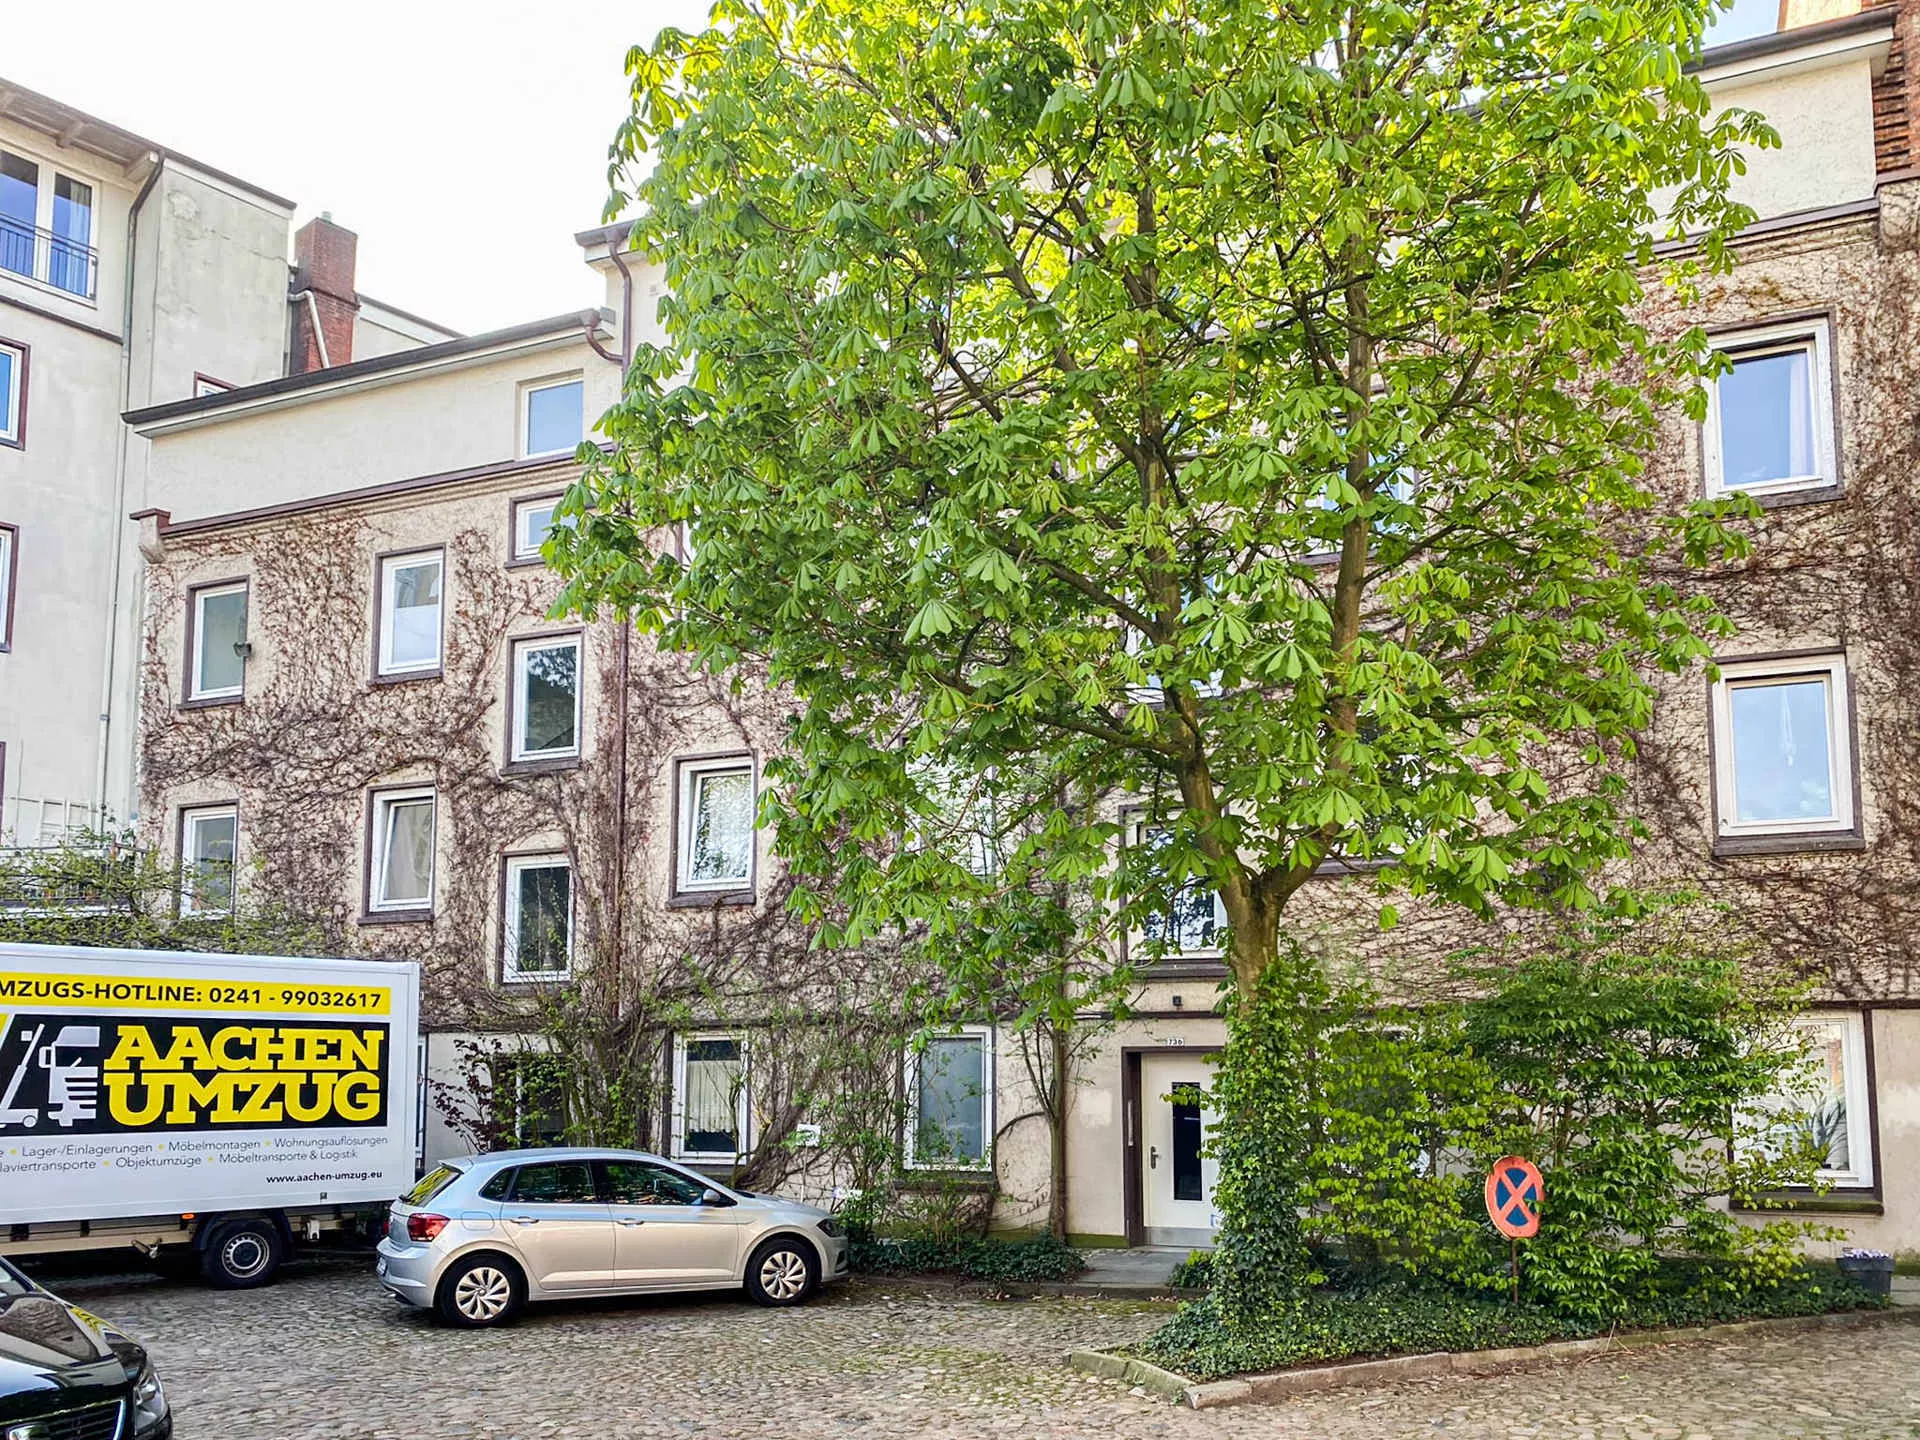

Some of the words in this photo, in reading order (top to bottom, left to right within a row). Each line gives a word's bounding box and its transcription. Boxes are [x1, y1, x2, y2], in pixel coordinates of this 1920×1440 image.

[0, 980, 202, 1002] MZUGS-HOTLINE:
[209, 988, 261, 1004] 0241
[281, 990, 381, 1008] 99032617
[103, 1025, 385, 1071] AACHEN
[103, 1071, 381, 1126] UMZUG
[22, 1144, 153, 1160] Lager-/Einlagerungen
[168, 1139, 261, 1152] Möbelmontagen
[274, 1135, 388, 1149] Wohnungsauflösungen
[115, 1156, 202, 1170] Objektumzüge
[219, 1149, 307, 1164] Möbeltransporte
[309, 1150, 318, 1160] &
[320, 1149, 358, 1162] Logistik
[266, 1171, 383, 1184] www.aachen-umzug.eu
